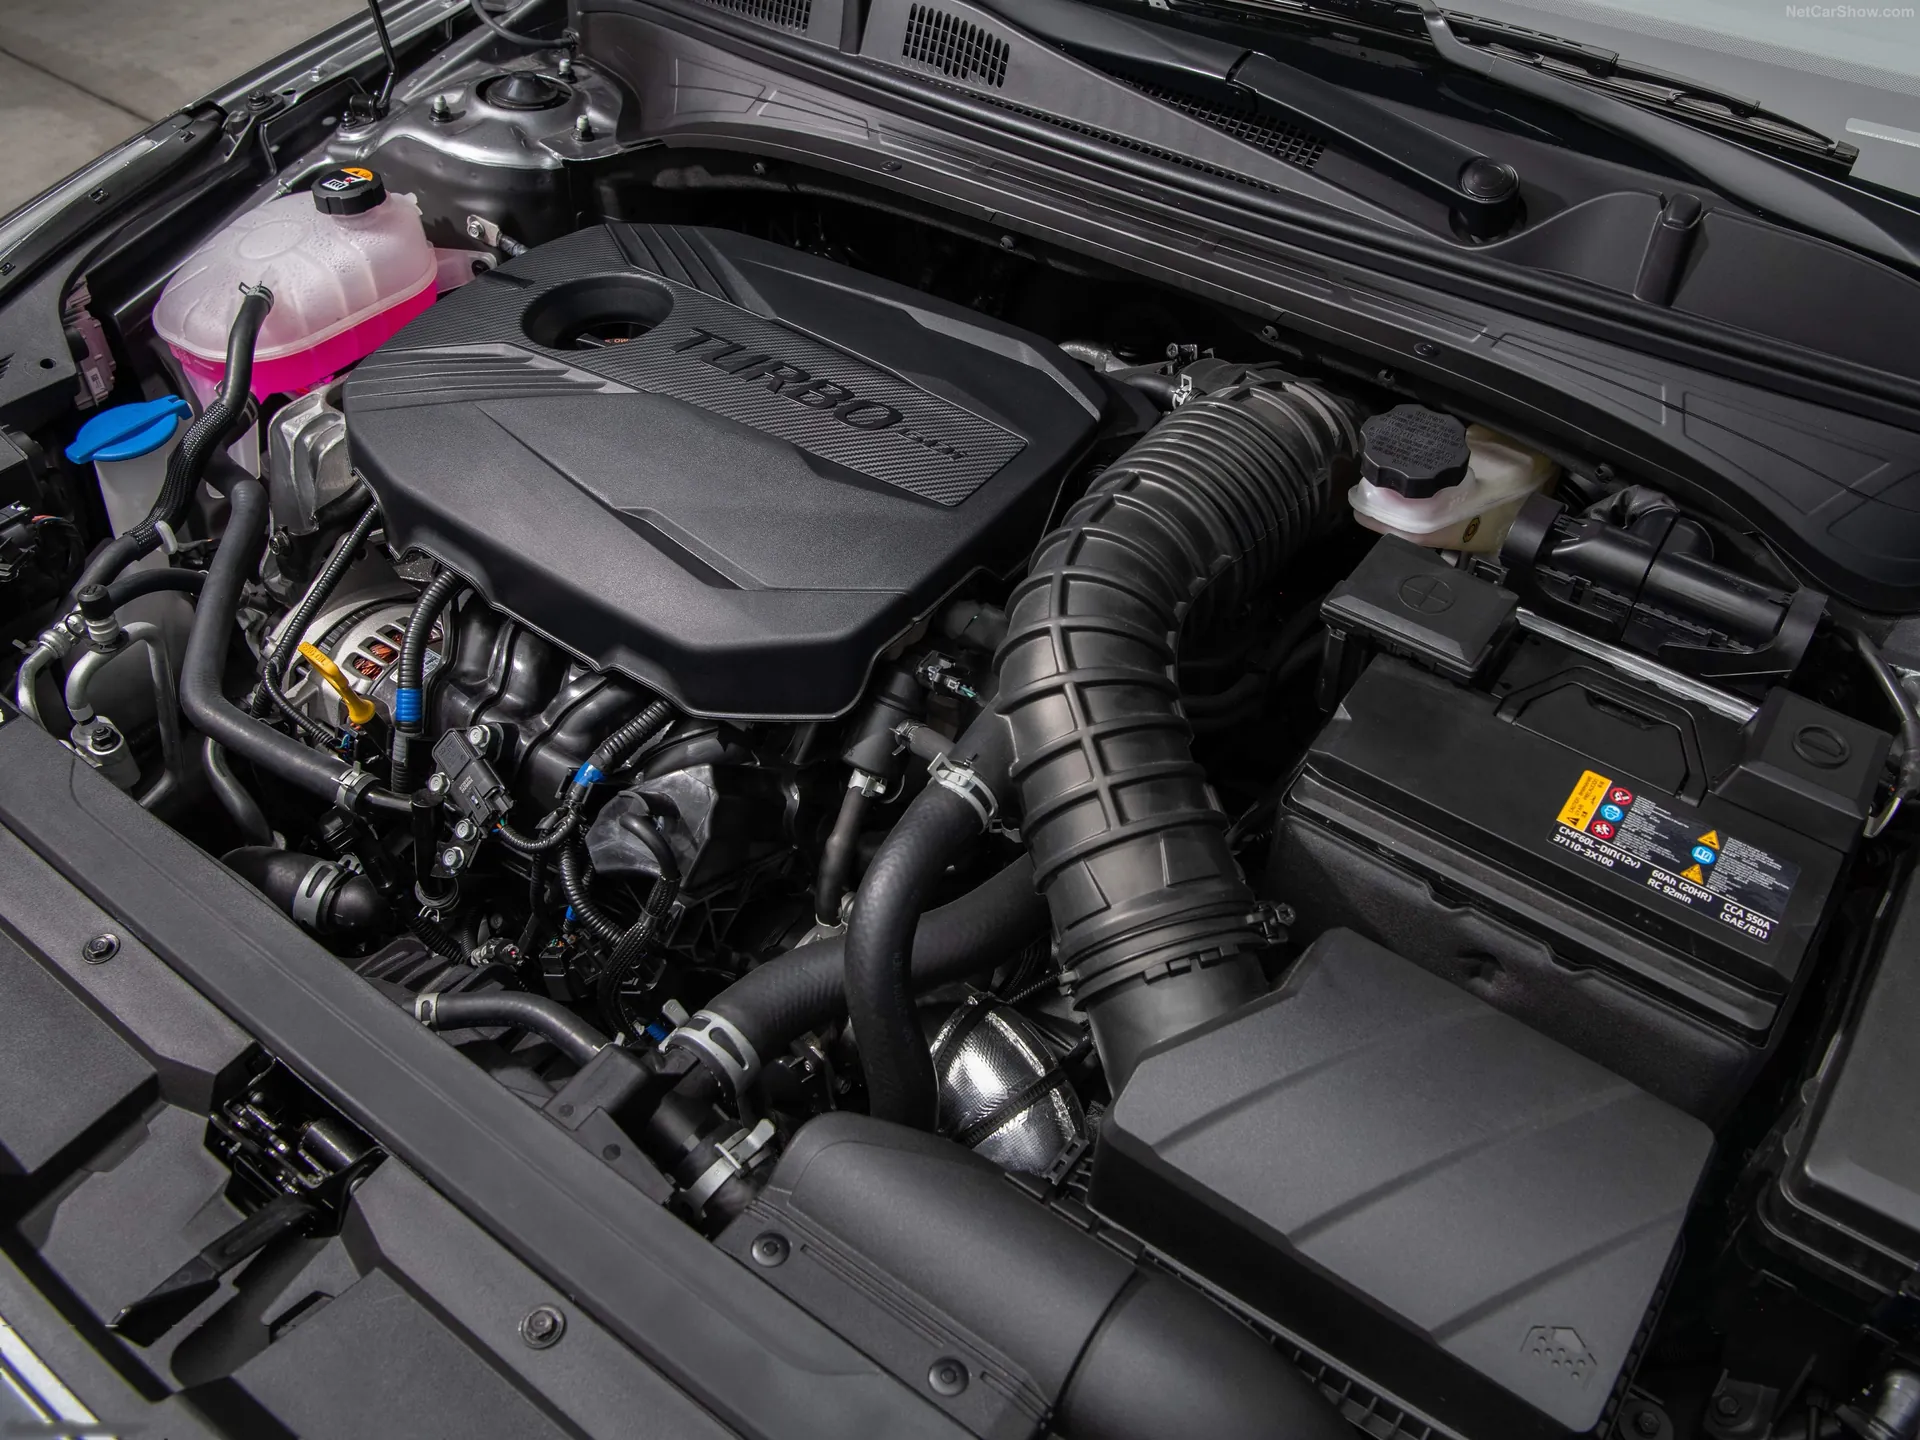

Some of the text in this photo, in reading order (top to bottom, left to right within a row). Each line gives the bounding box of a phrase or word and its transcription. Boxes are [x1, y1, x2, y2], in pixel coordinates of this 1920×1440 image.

[670, 327, 903, 430] TURBO
[1553, 834, 1615, 867] 37110-3X100
[1647, 878, 1692, 904] RC 92min
[1652, 869, 1713, 903] 60Ah (20HR)
[1723, 903, 1771, 930] CCA 550A
